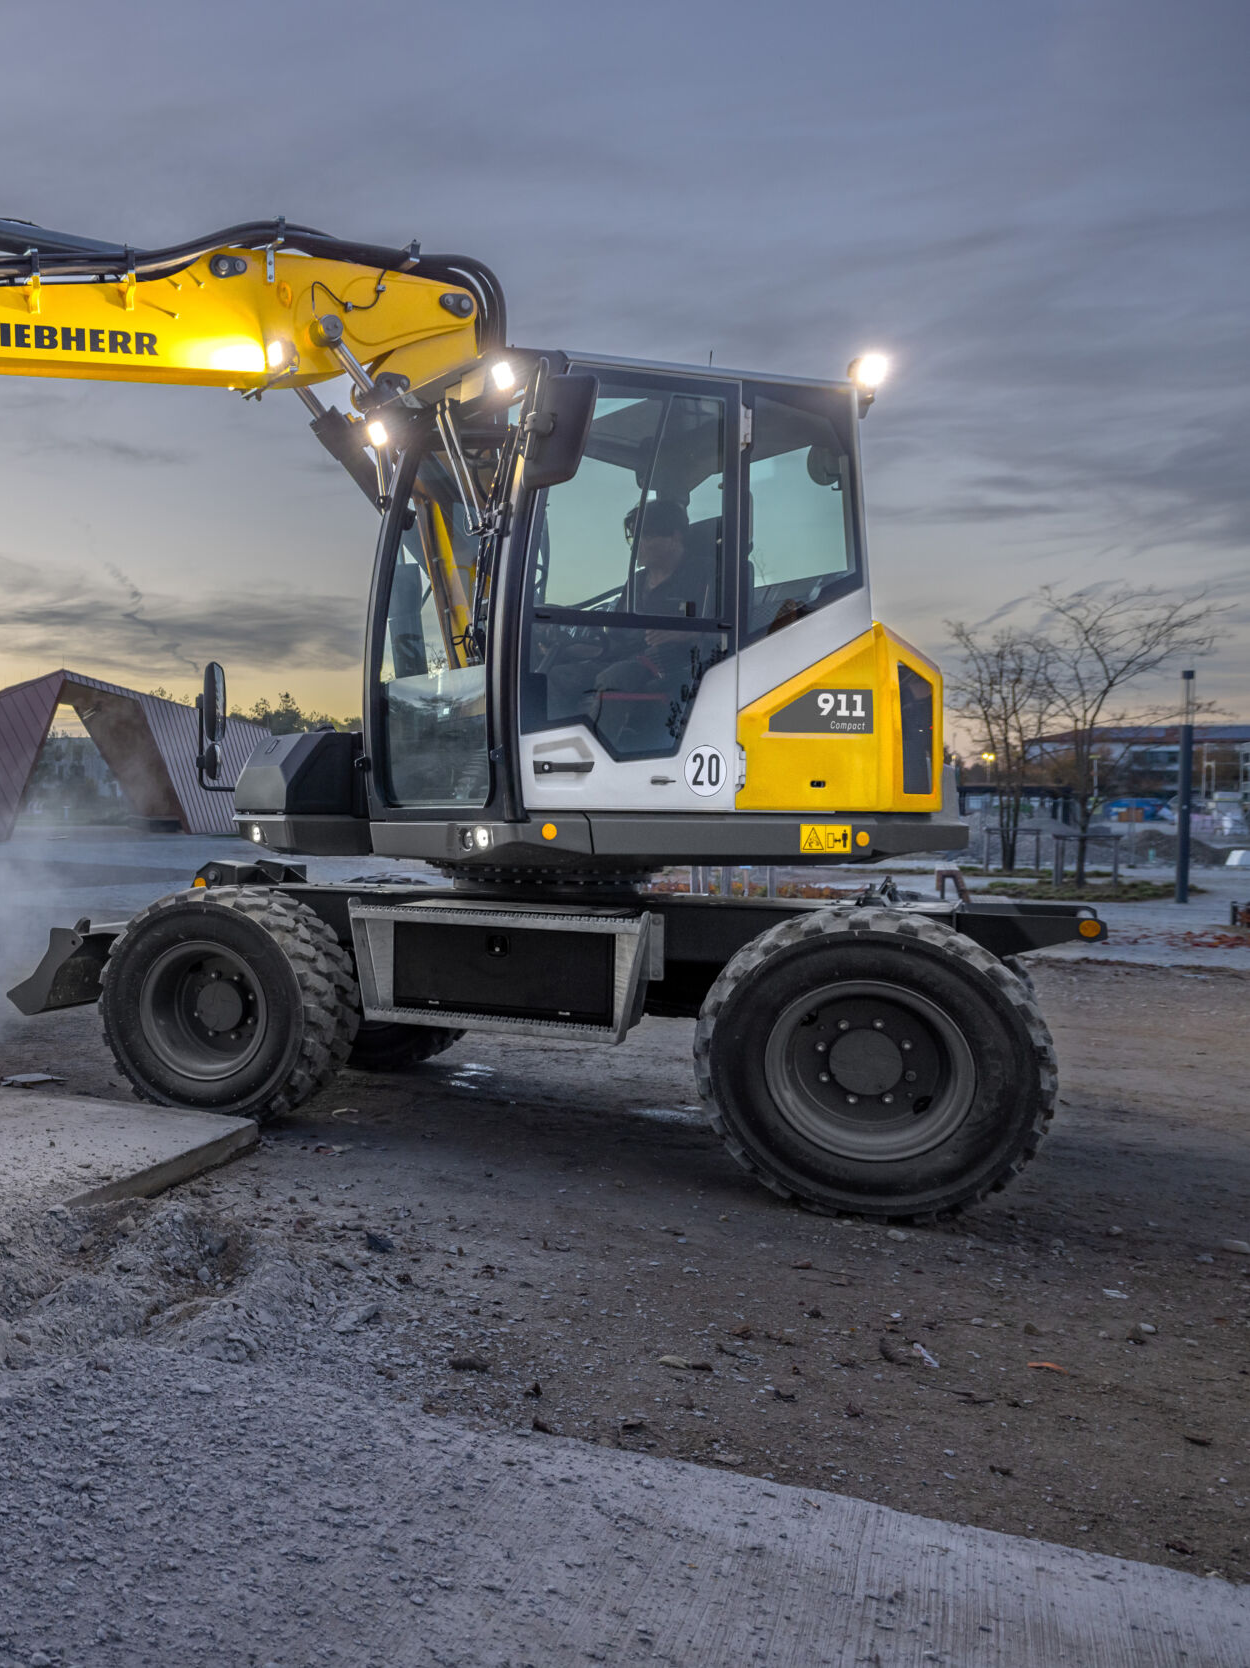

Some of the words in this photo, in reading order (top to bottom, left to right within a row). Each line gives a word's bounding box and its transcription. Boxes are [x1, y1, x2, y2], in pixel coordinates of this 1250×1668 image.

[817, 693, 865, 717] 911
[830, 720, 865, 732] Compact
[692, 752, 720, 787] 20
